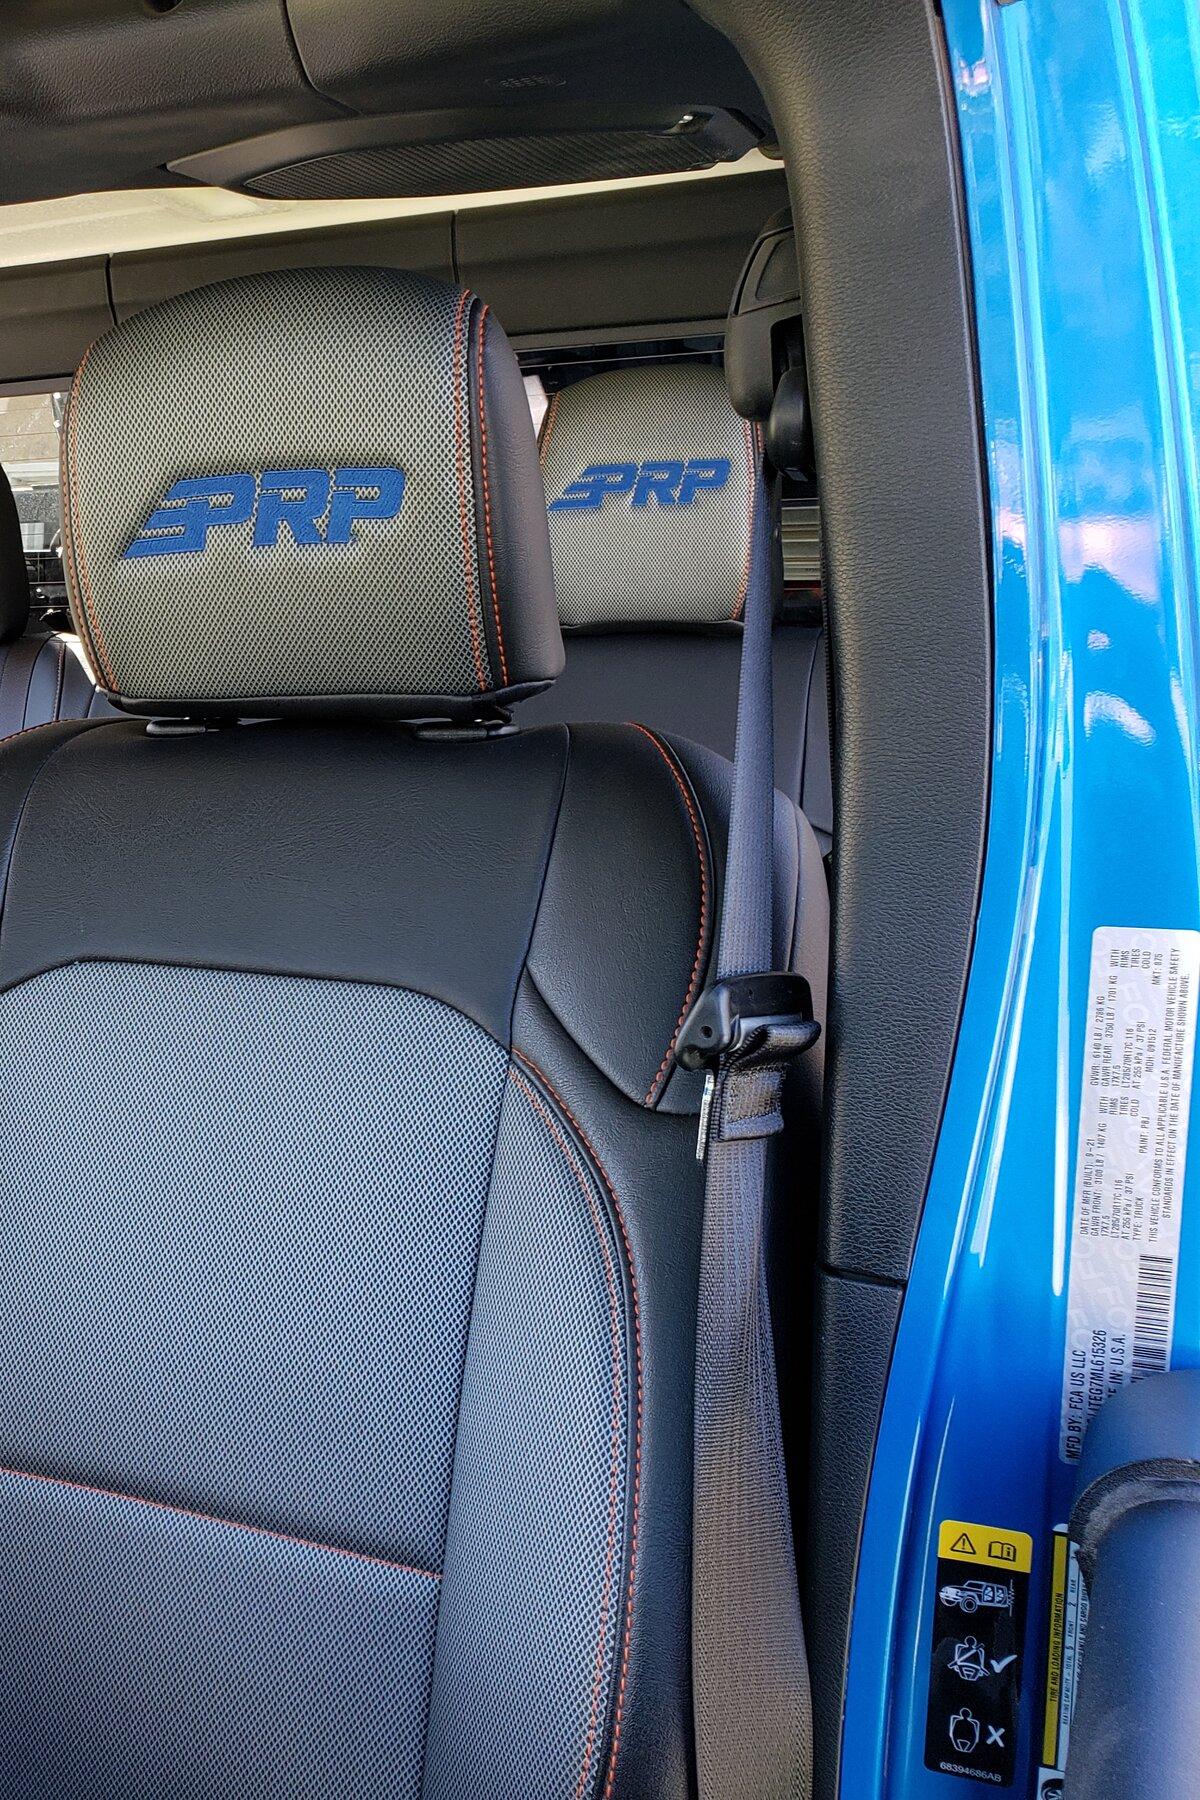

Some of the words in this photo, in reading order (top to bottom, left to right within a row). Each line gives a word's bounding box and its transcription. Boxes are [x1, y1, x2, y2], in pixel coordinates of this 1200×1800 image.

[544, 458, 731, 511] PRP
[122, 466, 406, 559] PRP
[1110, 948, 1119, 967] WITH
[1120, 950, 1129, 968] RIMS
[1131, 947, 1140, 968] TIRES
[1141, 950, 1150, 969] COLD
[1169, 947, 1179, 974] SAFETY
[1108, 975, 1117, 984] KG
[1152, 968, 1161, 985] MKT:
[1178, 972, 1189, 998] ABOVE.
[1166, 976, 1177, 1005] VEHICLE
[1164, 1007, 1175, 1031] MOTOR
[1176, 1000, 1187, 1026] SHOWN
[1090, 1062, 1100, 1086] GVWR:
[1096, 995, 1105, 1005] KG
[1162, 1033, 1173, 1064] FEDERAL
[1103, 1043, 1112, 1063] REAR:
[1172, 1027, 1185, 1079] MANUFACTURE
[1101, 1065, 1111, 1086] GAWR
[1132, 1080, 1141, 1089] AT
[1160, 1067, 1170, 1088] U.S.A.
[1172, 1081, 1181, 1091] OF
[1099, 1095, 1108, 1113] WITH
[1109, 1097, 1118, 1115] RIMS
[1120, 1095, 1129, 1115] TIRES
[1130, 1099, 1139, 1116] COLD
[1157, 1089, 1167, 1131] APPLICABLE
[1170, 1093, 1179, 1111] DATE
[1098, 1122, 1106, 1132] KG
[1169, 1113, 1178, 1126] THE
[1139, 1130, 1148, 1153] PAINT:
[1156, 1133, 1164, 1145] ALL
[1168, 1128, 1177, 1139] ON
[1155, 1147, 1163, 1156] TO
[1166, 1140, 1176, 1165] EFFECT
[1083, 1161, 1094, 1187] (BUILT):
[1152, 1158, 1162, 1196] CONFORMS
[1165, 1167, 1174, 1175] IN
[1081, 1190, 1091, 1204] MFR
[1092, 1188, 1102, 1213] FRONT:
[1162, 1176, 1173, 1218] STANDARDS
[1081, 1206, 1090, 1215] OF
[1134, 1196, 1143, 1219] TRUCK
[1150, 1198, 1160, 1224] VEHICLE
[1079, 1217, 1089, 1235] DATE
[1090, 1215, 1100, 1236] GAWR
[1121, 1230, 1129, 1239] AT
[1132, 1221, 1141, 1240] TYPE:
[1148, 1226, 1157, 1243] THIS
[1071, 1349, 1085, 1368] LLC
[1110, 1333, 1125, 1365] U.S.A.
[1070, 1371, 1084, 1386] US
[1109, 1369, 1123, 1384] IN:
[1068, 1389, 1083, 1410] FCA
[1067, 1414, 1082, 1432] BY:
[1065, 1435, 1080, 1459] MFD
[1053, 1593, 1063, 1638] INFORMATION
[1052, 1641, 1061, 1670] LOADING
[1051, 1672, 1059, 1686] AND
[1050, 1688, 1058, 1702] TIRE
